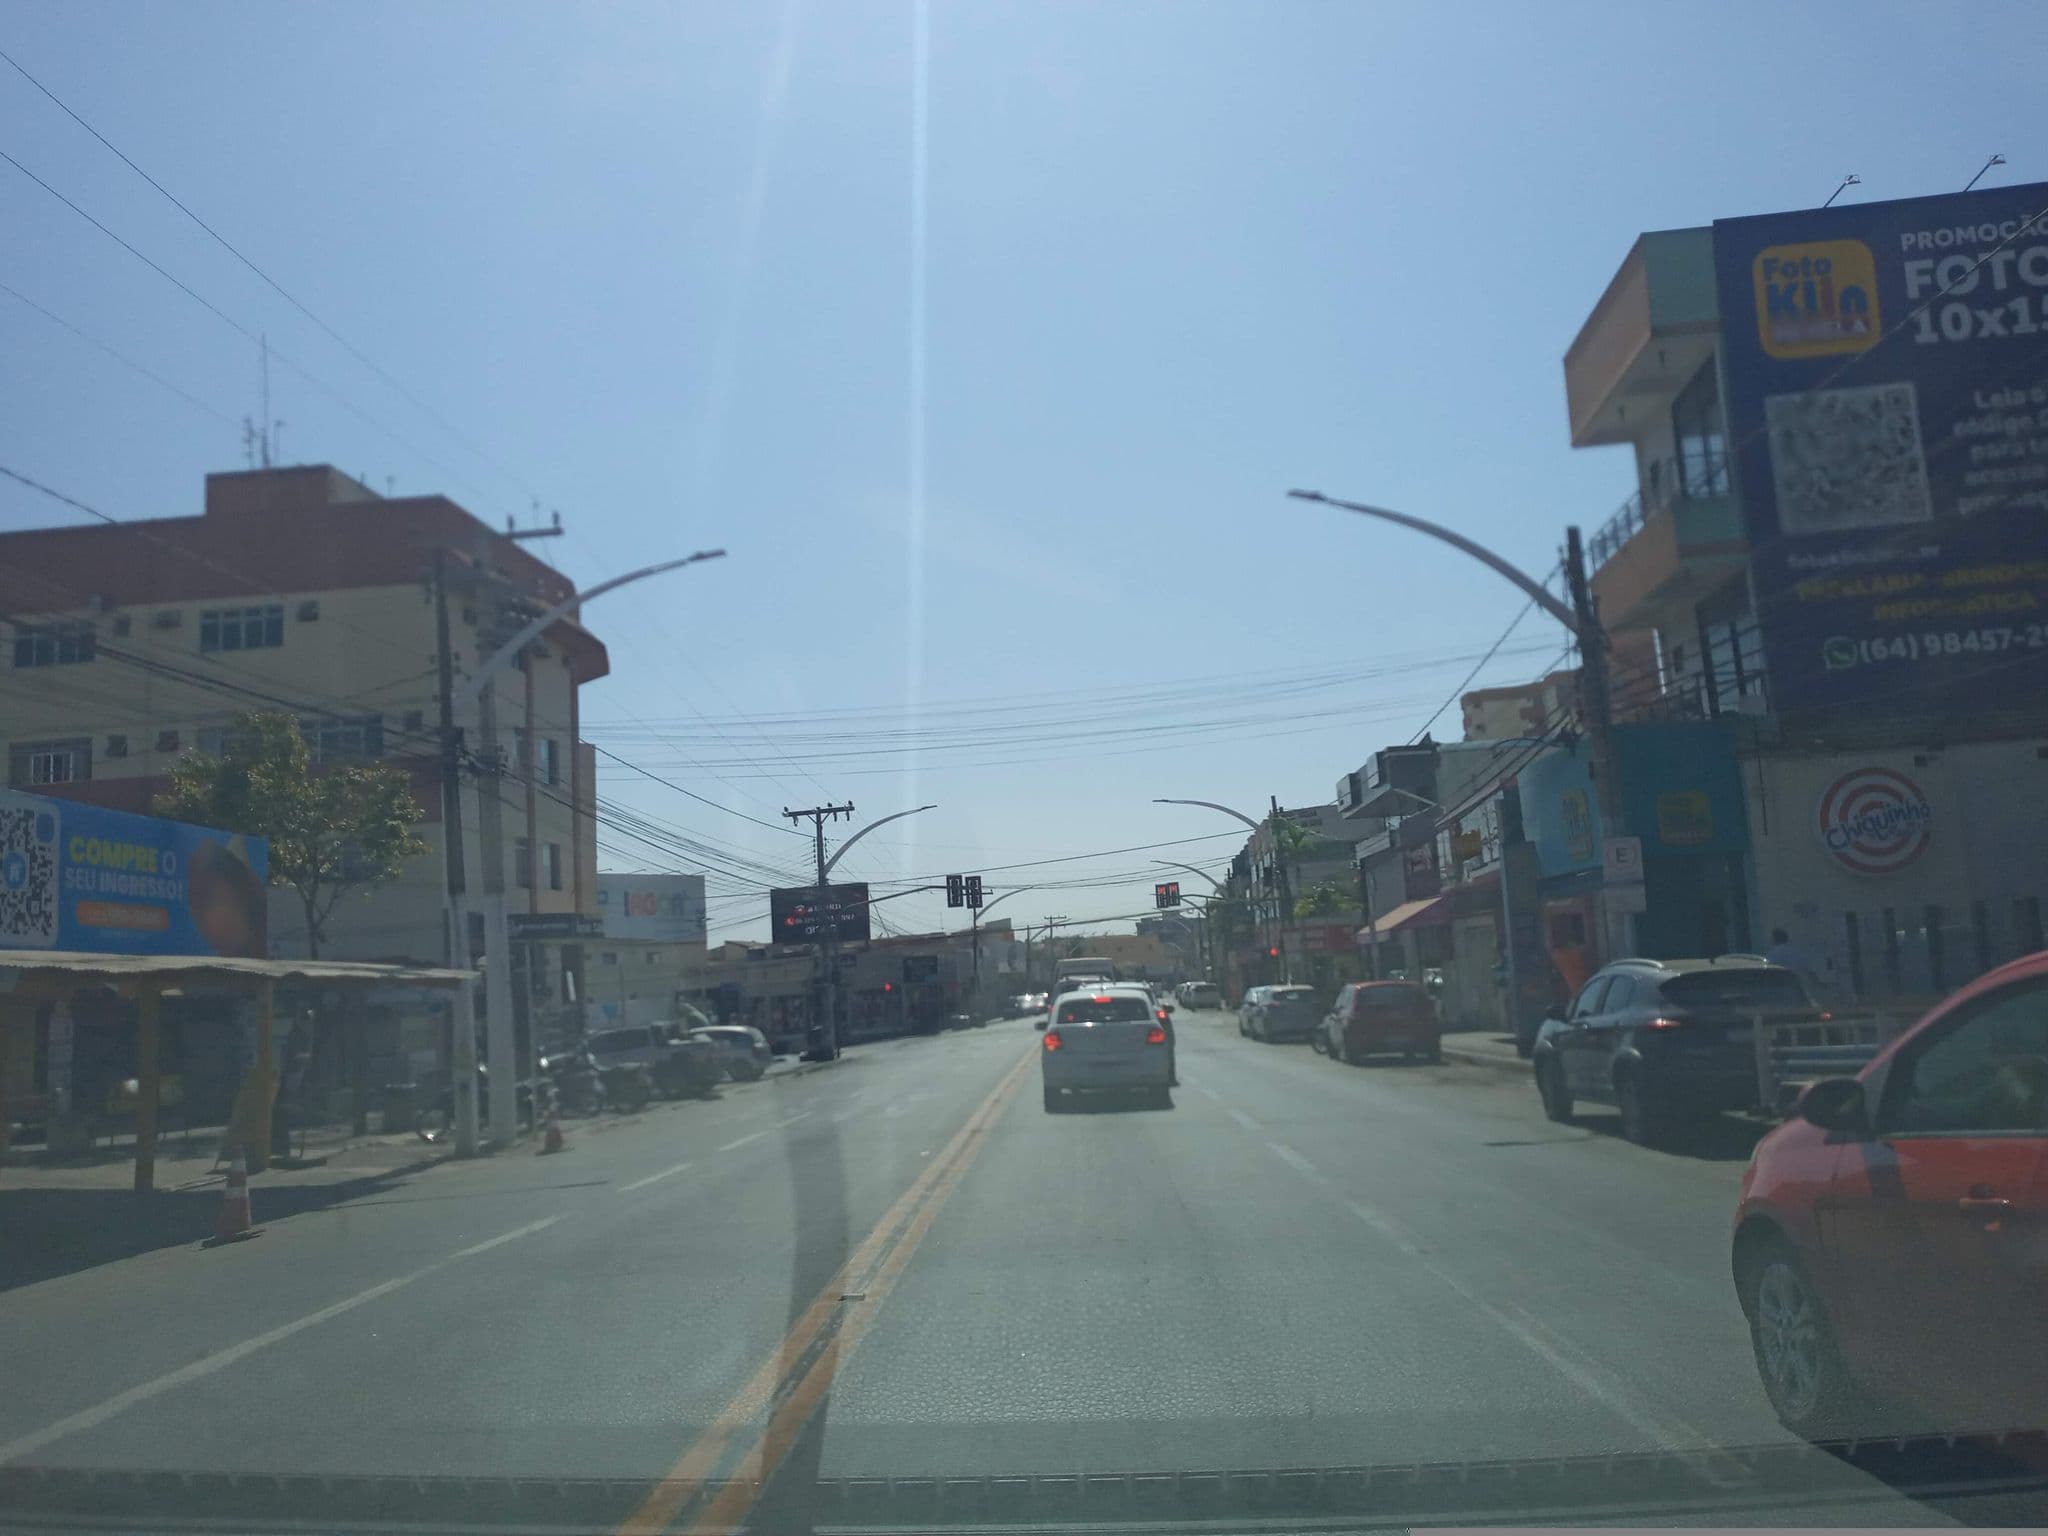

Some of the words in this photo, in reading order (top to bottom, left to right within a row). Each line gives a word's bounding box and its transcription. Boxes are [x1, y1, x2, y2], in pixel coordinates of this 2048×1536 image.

[1860, 633, 1919, 664] (64)
[69, 835, 159, 873] COMPRE
[162, 850, 177, 875] O
[64, 867, 97, 892] SEU
